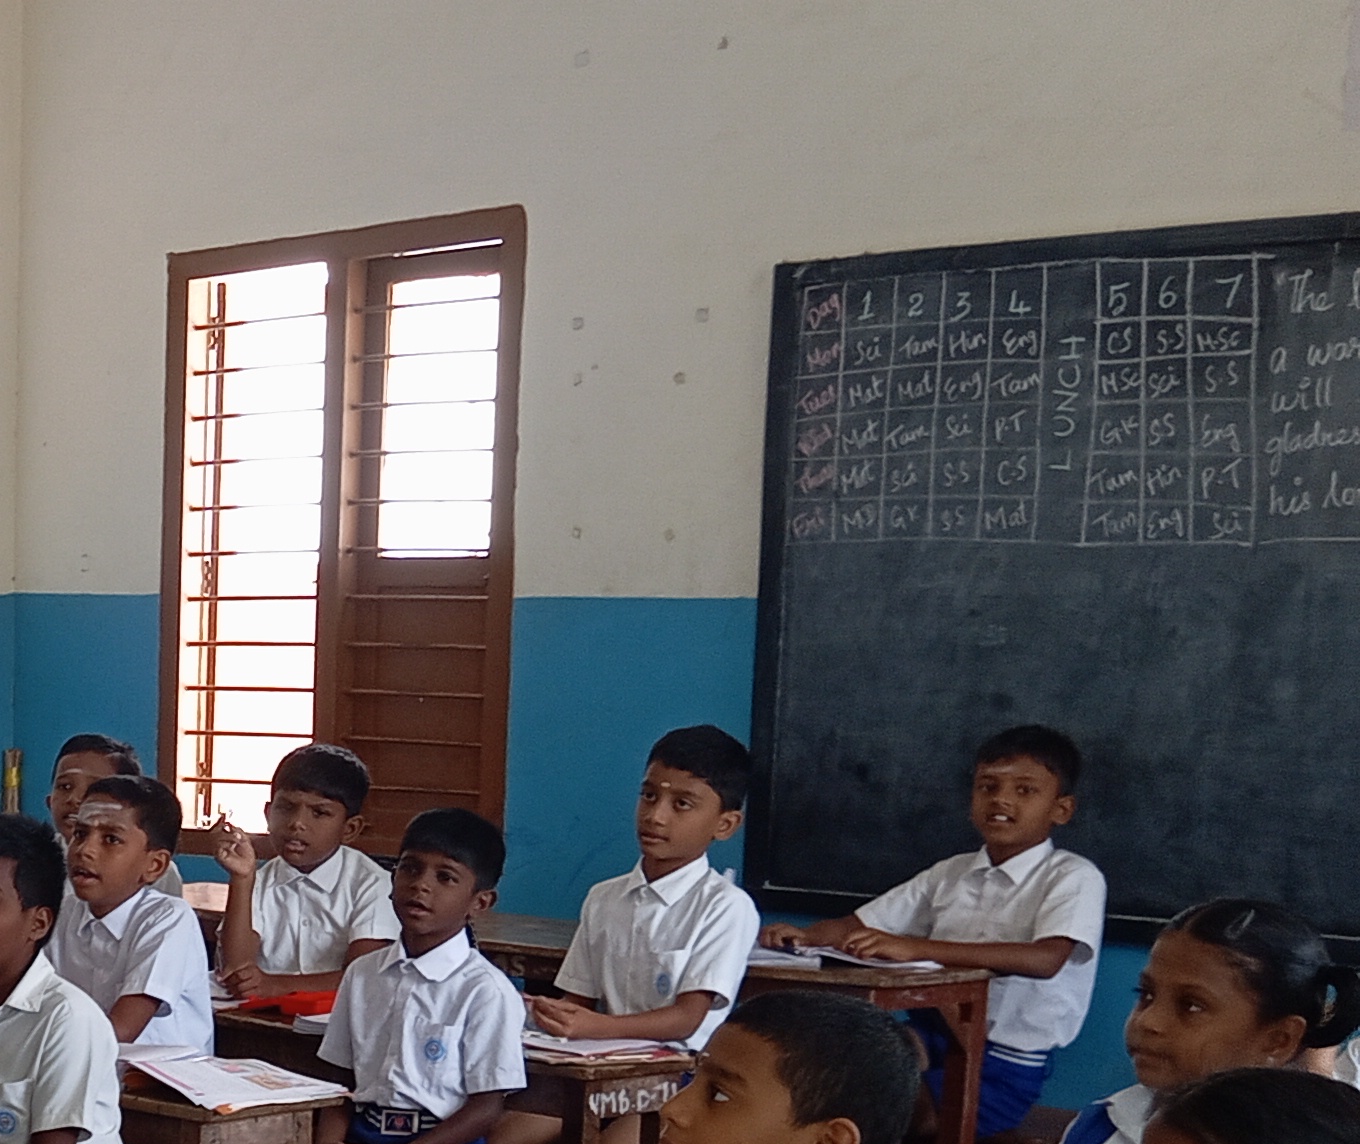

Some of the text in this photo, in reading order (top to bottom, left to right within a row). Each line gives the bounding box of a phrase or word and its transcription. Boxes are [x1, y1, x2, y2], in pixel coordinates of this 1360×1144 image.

[857, 290, 876, 321] 1
[907, 292, 925, 317] 2
[949, 291, 972, 323] 3
[1008, 289, 1032, 318] 4
[1108, 282, 1131, 317] 5
[1158, 275, 1178, 309] 6
[1215, 273, 1243, 309] 7
[1288, 268, 1336, 313] The
[854, 336, 882, 366] Sci
[1002, 328, 1038, 356] Eng
[1270, 346, 1287, 375] a
[898, 369, 934, 401] Mat
[990, 371, 1041, 398] Tam
[1048, 335, 1087, 471] LUNCH
[1271, 374, 1333, 414] will
[984, 498, 1029, 532] Mat
[1269, 475, 1311, 515] his
